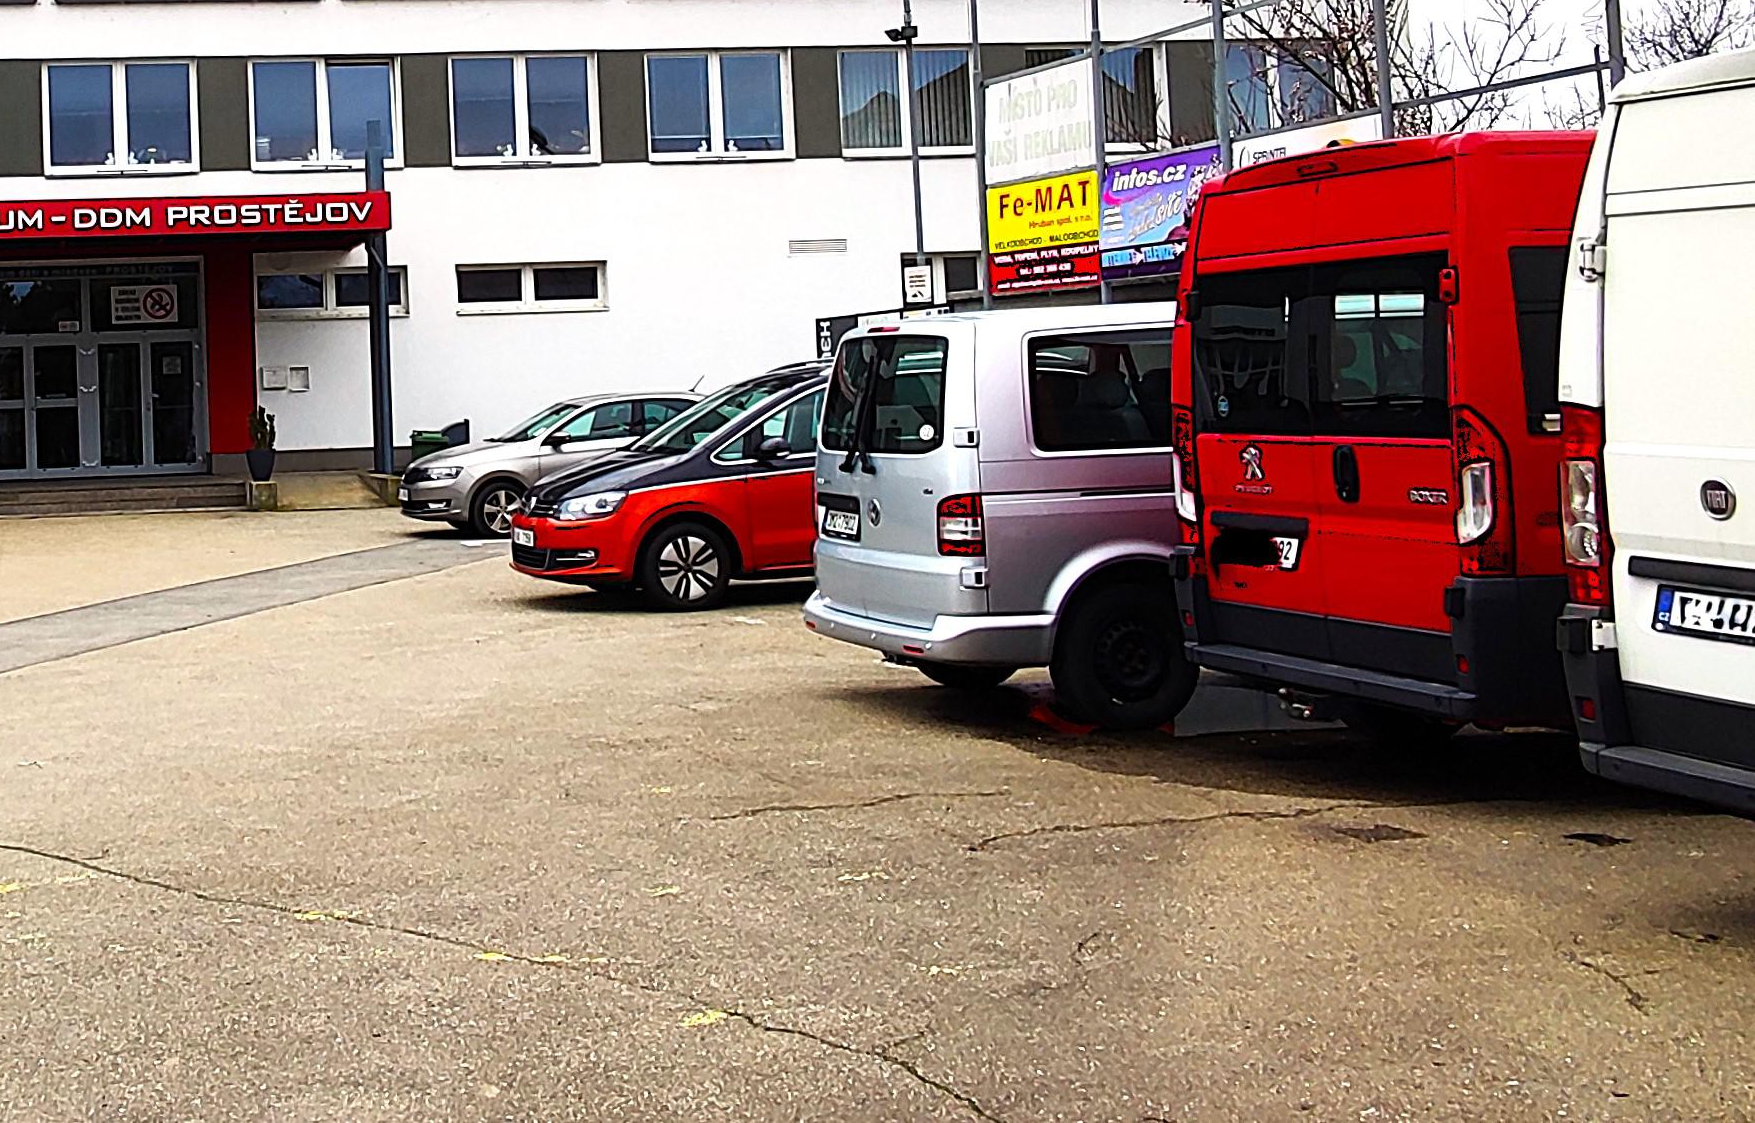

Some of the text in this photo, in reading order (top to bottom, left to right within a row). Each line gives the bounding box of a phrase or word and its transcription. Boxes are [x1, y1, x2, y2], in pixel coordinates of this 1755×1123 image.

[1047, 79, 1078, 113] PRO
[1112, 163, 1188, 192] infos.cz
[73, 206, 151, 230] DDM
[166, 197, 375, 227] PROSTĚJOV
[999, 180, 1090, 219] Fe-MAT
